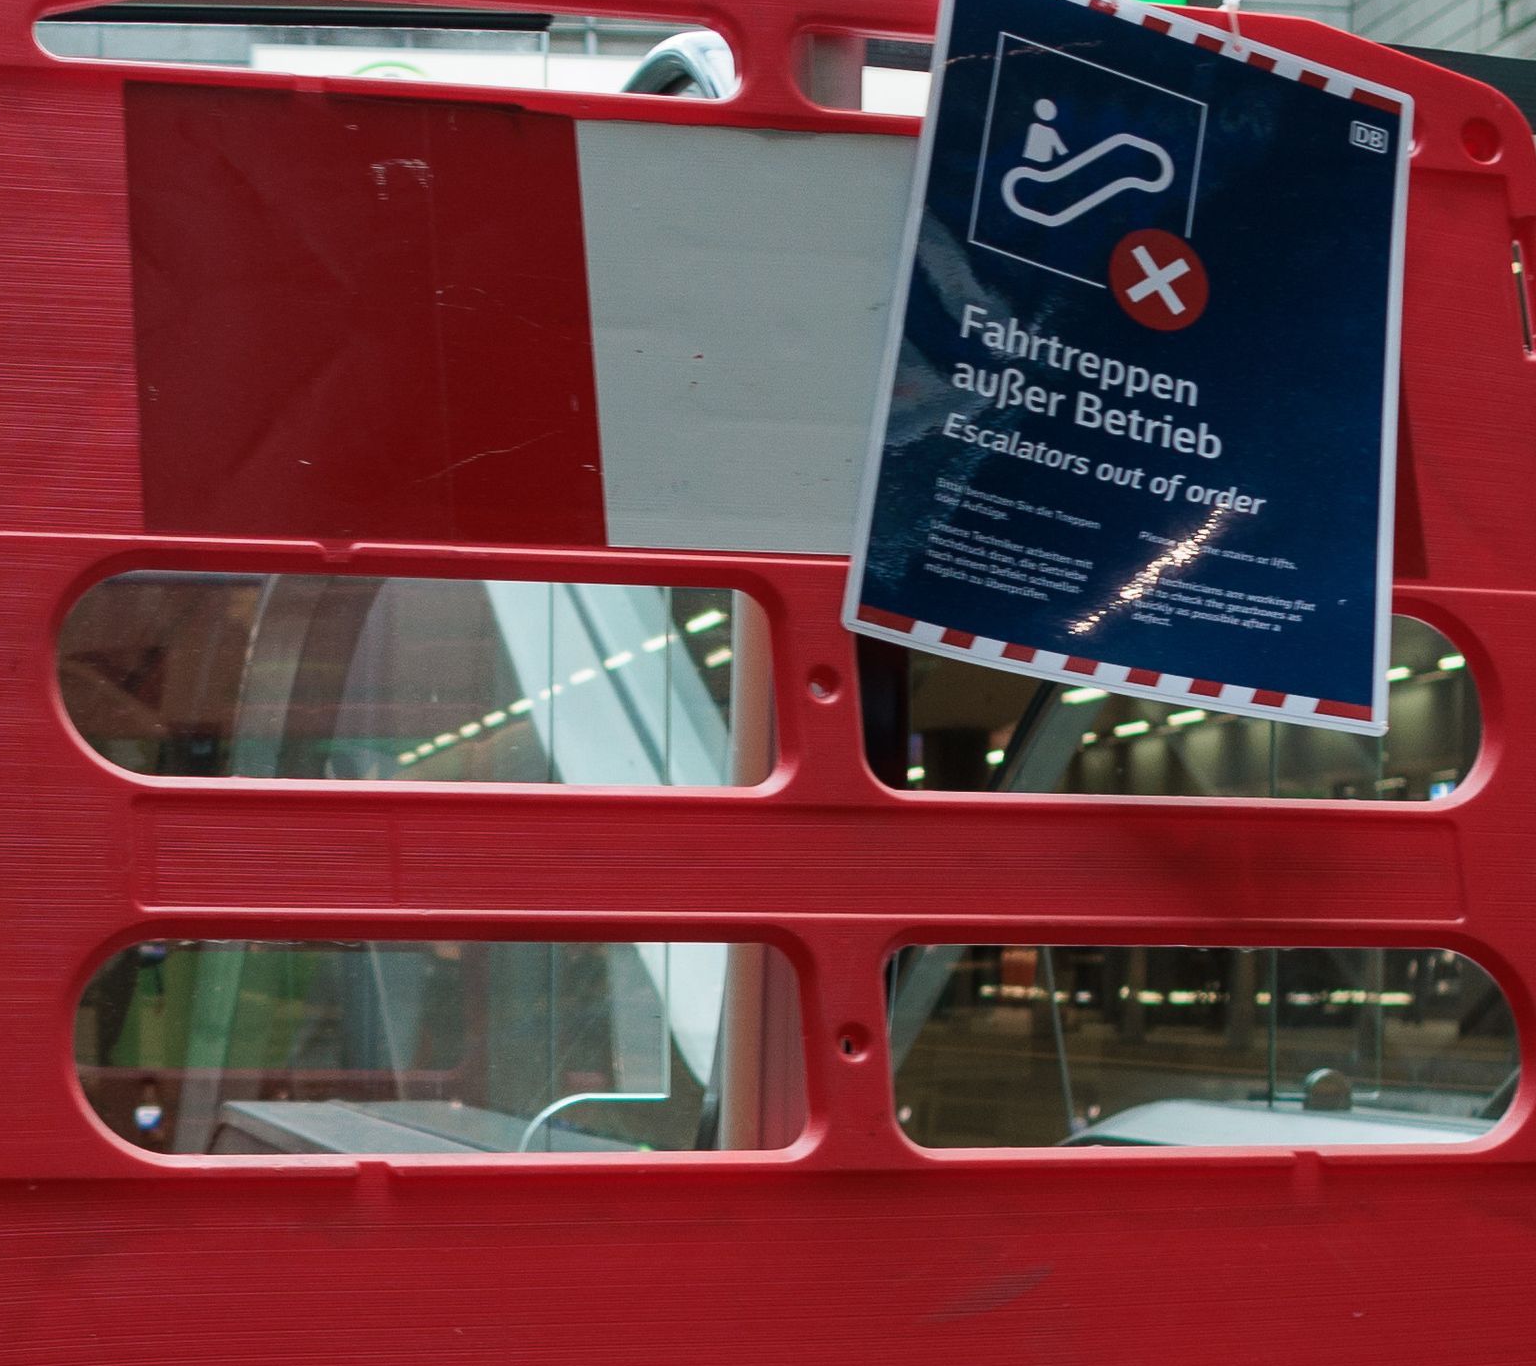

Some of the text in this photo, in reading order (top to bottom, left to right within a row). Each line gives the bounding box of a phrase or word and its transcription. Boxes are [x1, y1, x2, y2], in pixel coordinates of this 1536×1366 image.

[1353, 124, 1386, 150] DB
[960, 304, 1200, 409] Fahrtreppen
[952, 359, 1223, 462] außer Betrieb
[943, 413, 1266, 516] Escalators out of order
